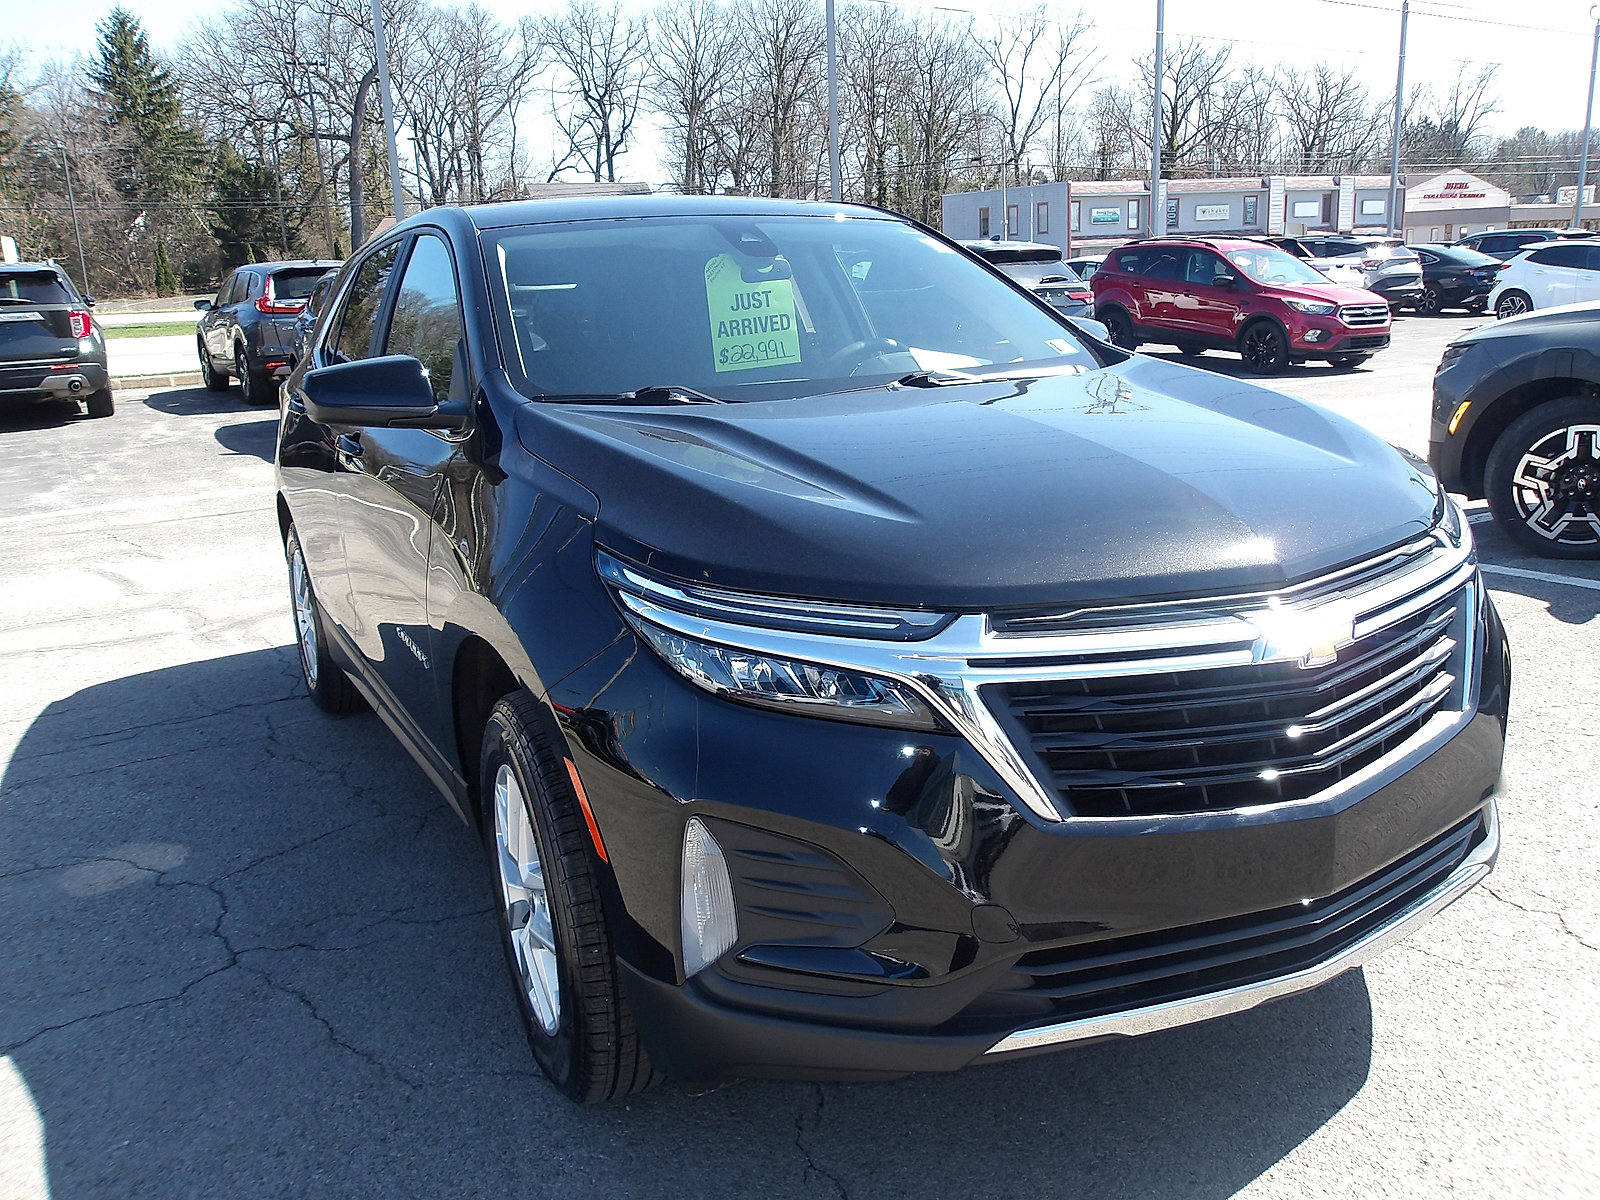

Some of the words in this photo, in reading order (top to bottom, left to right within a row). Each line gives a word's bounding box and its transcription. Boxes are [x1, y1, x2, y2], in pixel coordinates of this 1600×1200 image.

[1167, 201, 1177, 224] YOGA
[731, 290, 772, 312] JUST
[717, 313, 791, 338] ARRIVED
[719, 340, 789, 366] $22,991
